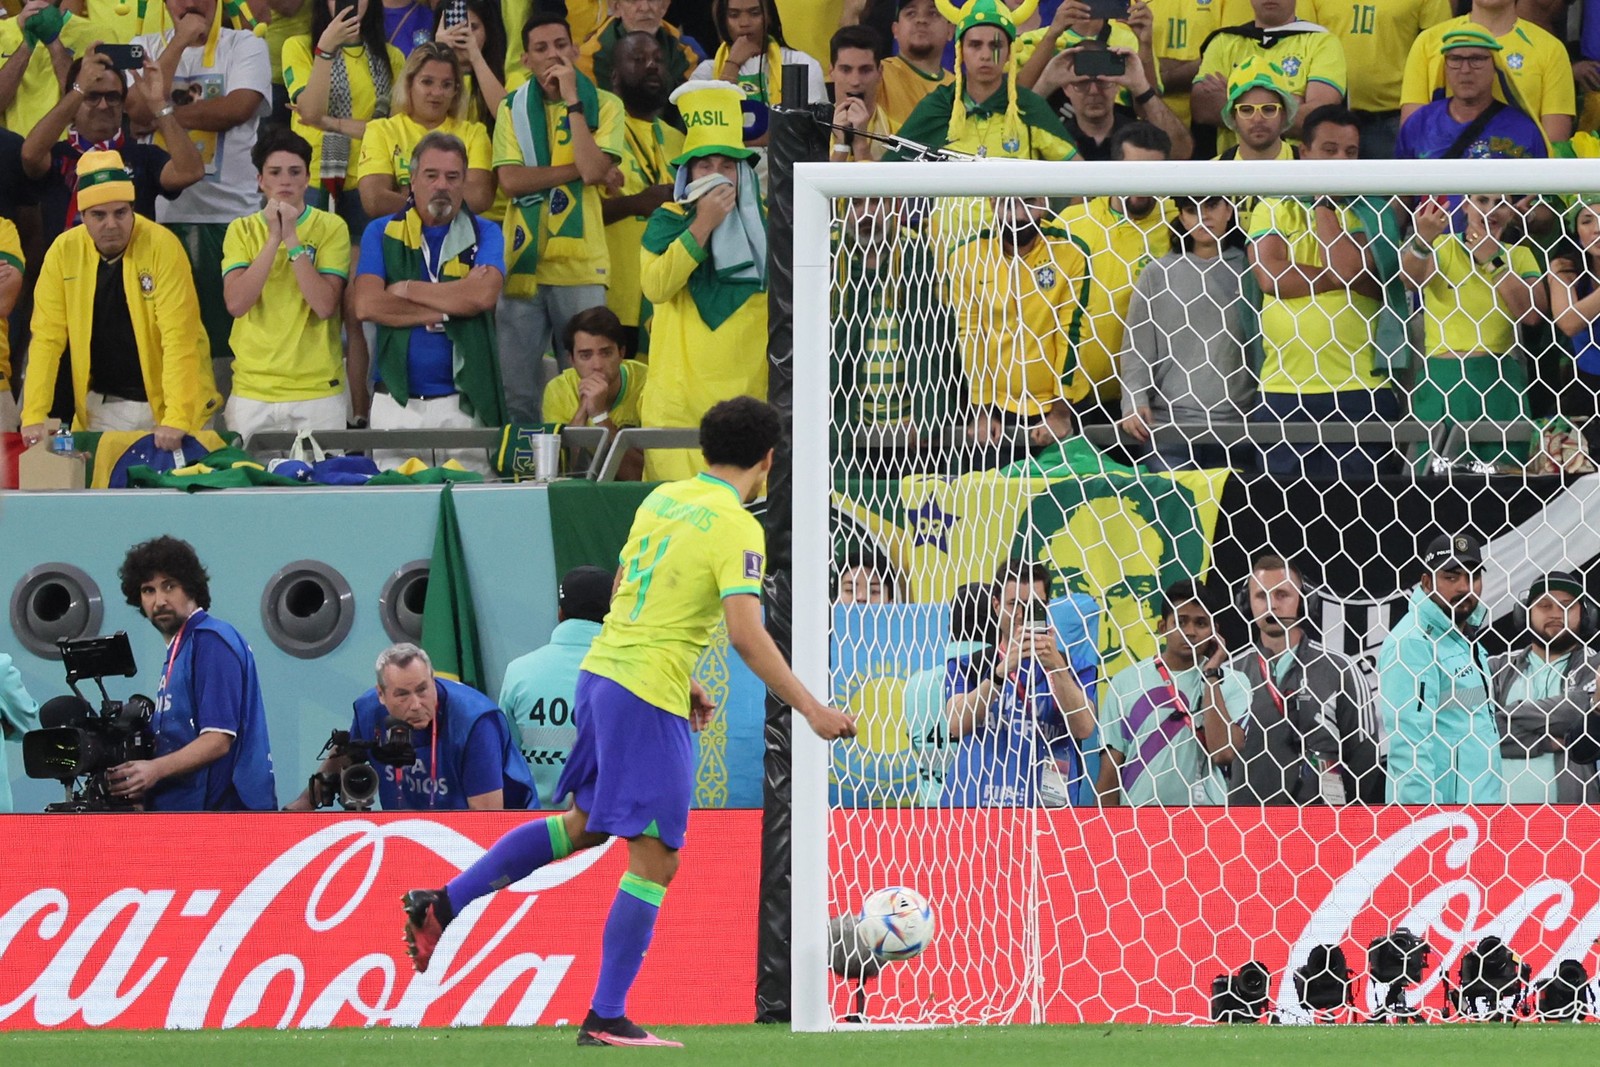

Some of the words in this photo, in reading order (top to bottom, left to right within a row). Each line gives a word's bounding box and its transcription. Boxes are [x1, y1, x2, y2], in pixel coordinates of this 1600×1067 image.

[1167, 17, 1187, 49] 10
[1350, 4, 1375, 35] 10
[625, 534, 672, 621] 4
